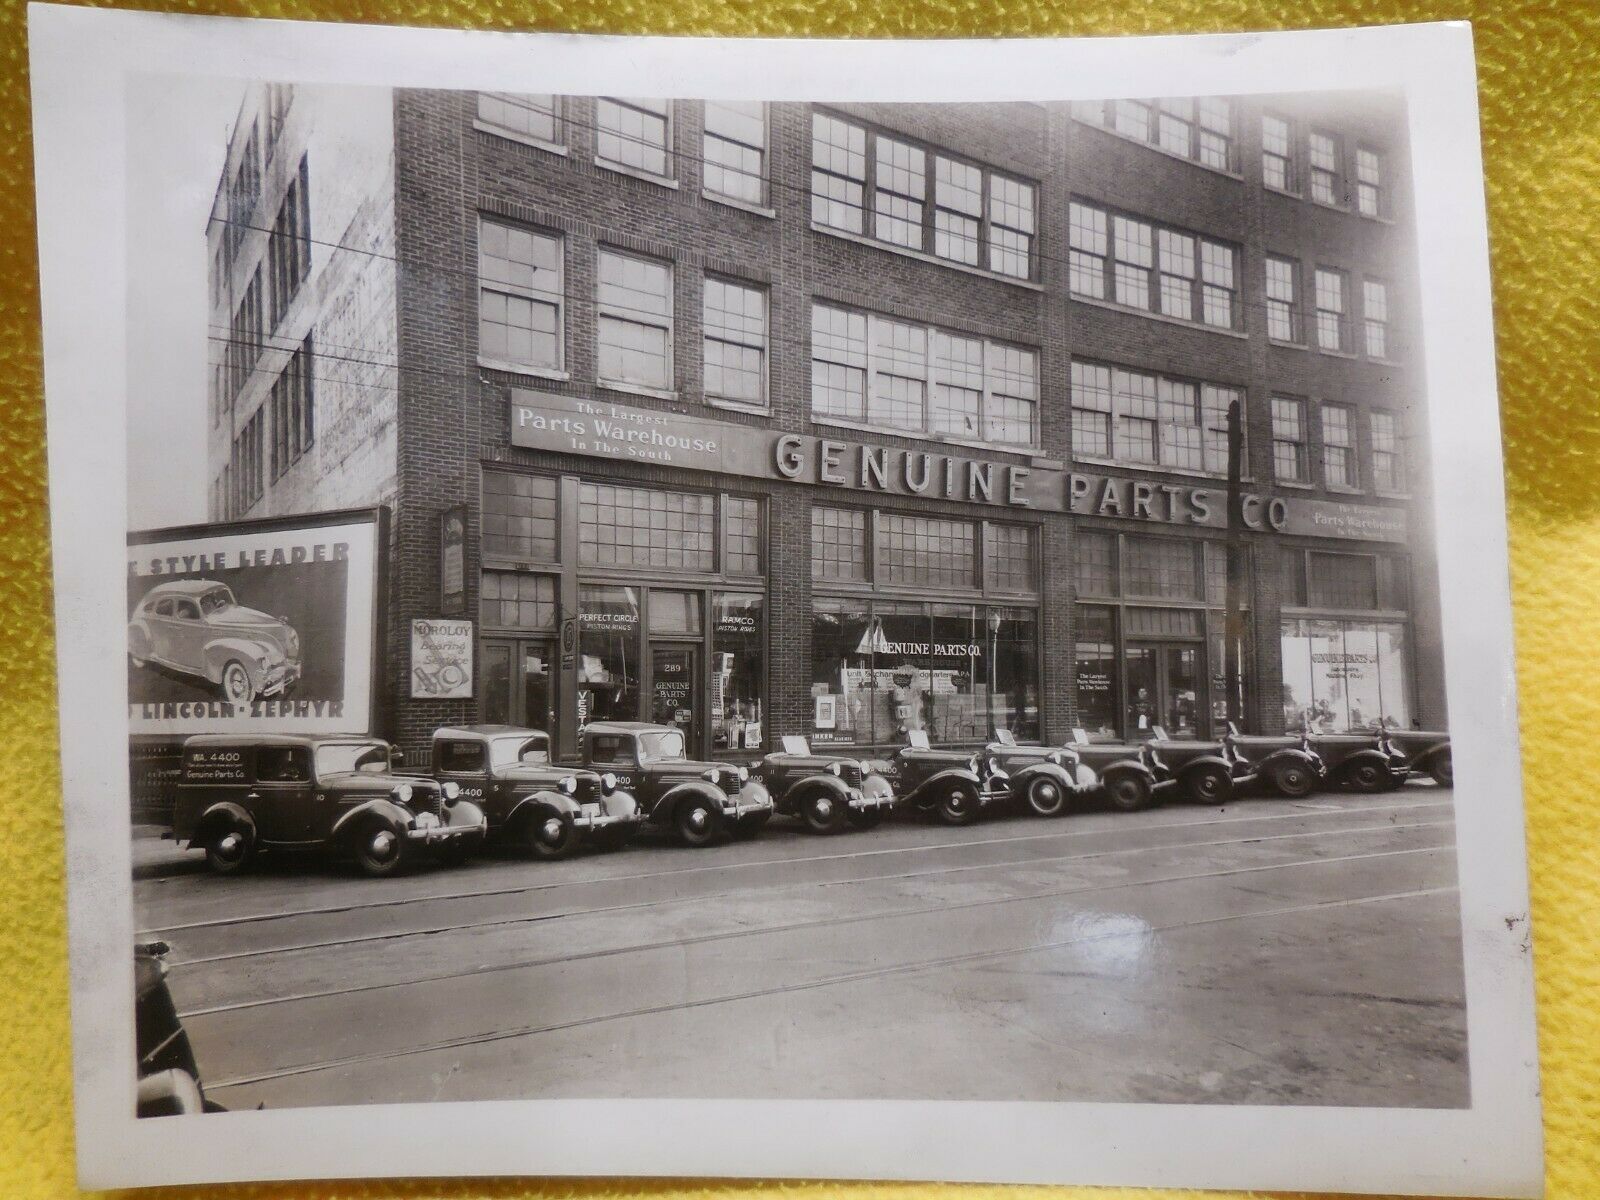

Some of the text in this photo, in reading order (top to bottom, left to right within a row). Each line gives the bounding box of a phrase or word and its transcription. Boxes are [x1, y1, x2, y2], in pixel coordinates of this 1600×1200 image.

[577, 402, 669, 427] The Largest
[519, 408, 717, 454] Parts Warehouse
[571, 438, 672, 461] In The South
[776, 434, 1289, 532] GENUINE PARTS CO
[150, 552, 225, 576] STYLE
[239, 542, 349, 568] LEADER
[579, 613, 639, 623] PERFECT CIRCLE
[611, 623, 632, 631] RINGS
[881, 641, 930, 655] GENUINE
[933, 644, 967, 656] PARTS
[664, 664, 681, 672] 289
[656, 682, 690, 690] GENUINE
[660, 690, 686, 698] PARTS
[210, 752, 240, 761] 4400
[187, 769, 214, 779] Genuine
[215, 770, 234, 778] Parts
